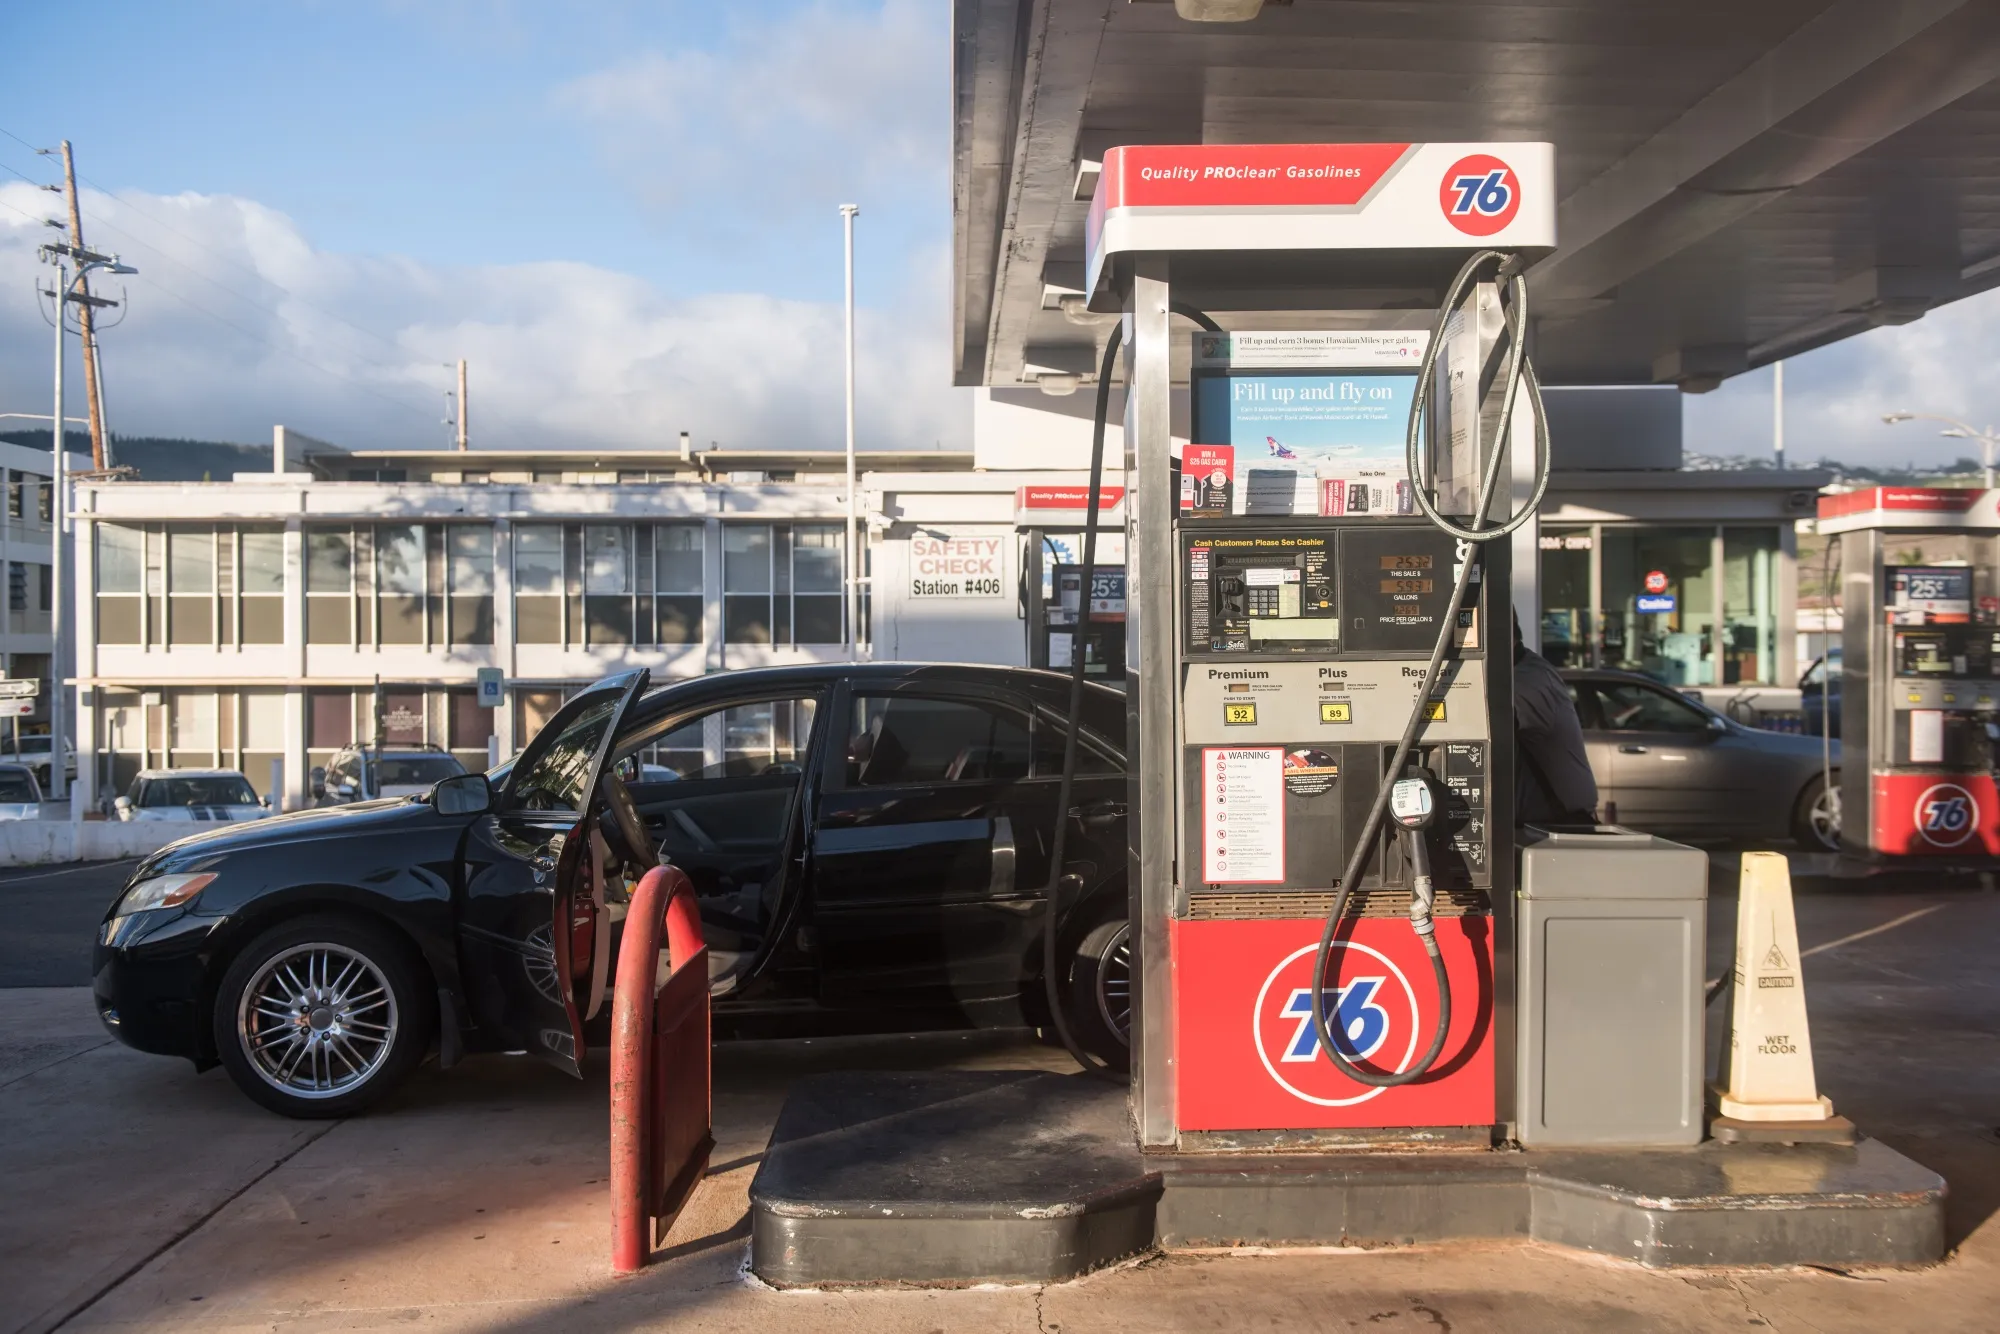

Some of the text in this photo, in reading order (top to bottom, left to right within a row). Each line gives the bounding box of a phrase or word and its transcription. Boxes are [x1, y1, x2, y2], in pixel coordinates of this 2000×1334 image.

[1141, 166, 1198, 182] Quality
[1286, 165, 1361, 179] Gasolines
[1449, 168, 1511, 217] 76
[1239, 337, 1252, 345] Fill
[1264, 337, 1278, 345] and
[1297, 337, 1302, 345] 3
[1303, 337, 1325, 345] bonus
[1382, 338, 1394, 346] per
[1396, 336, 1417, 345] gallon
[1234, 382, 1392, 405] Fill up and fly on
[1031, 492, 1054, 500] Quality
[913, 540, 999, 555] SAFETY
[1214, 539, 1253, 547] Customers
[919, 559, 994, 574] CHECK
[913, 579, 1000, 595] Station #406
[1208, 669, 1270, 680] Premium
[1318, 668, 1348, 679] Plus
[1402, 667, 1453, 680] Regar
[1233, 709, 1248, 719] 92
[1329, 710, 1342, 718] 89
[1425, 708, 1436, 716] 87
[1447, 745, 1453, 754] 1
[1228, 751, 1270, 760] WARNING
[1447, 778, 1454, 787] 2
[1448, 810, 1454, 819] 3
[1924, 797, 1967, 830] 76
[1448, 843, 1454, 852] 4
[1759, 978, 1793, 987] CAUTION
[1279, 976, 1389, 1063] 76
[1765, 1035, 1789, 1044] WET
[1758, 1045, 1797, 1054] FLOOR
